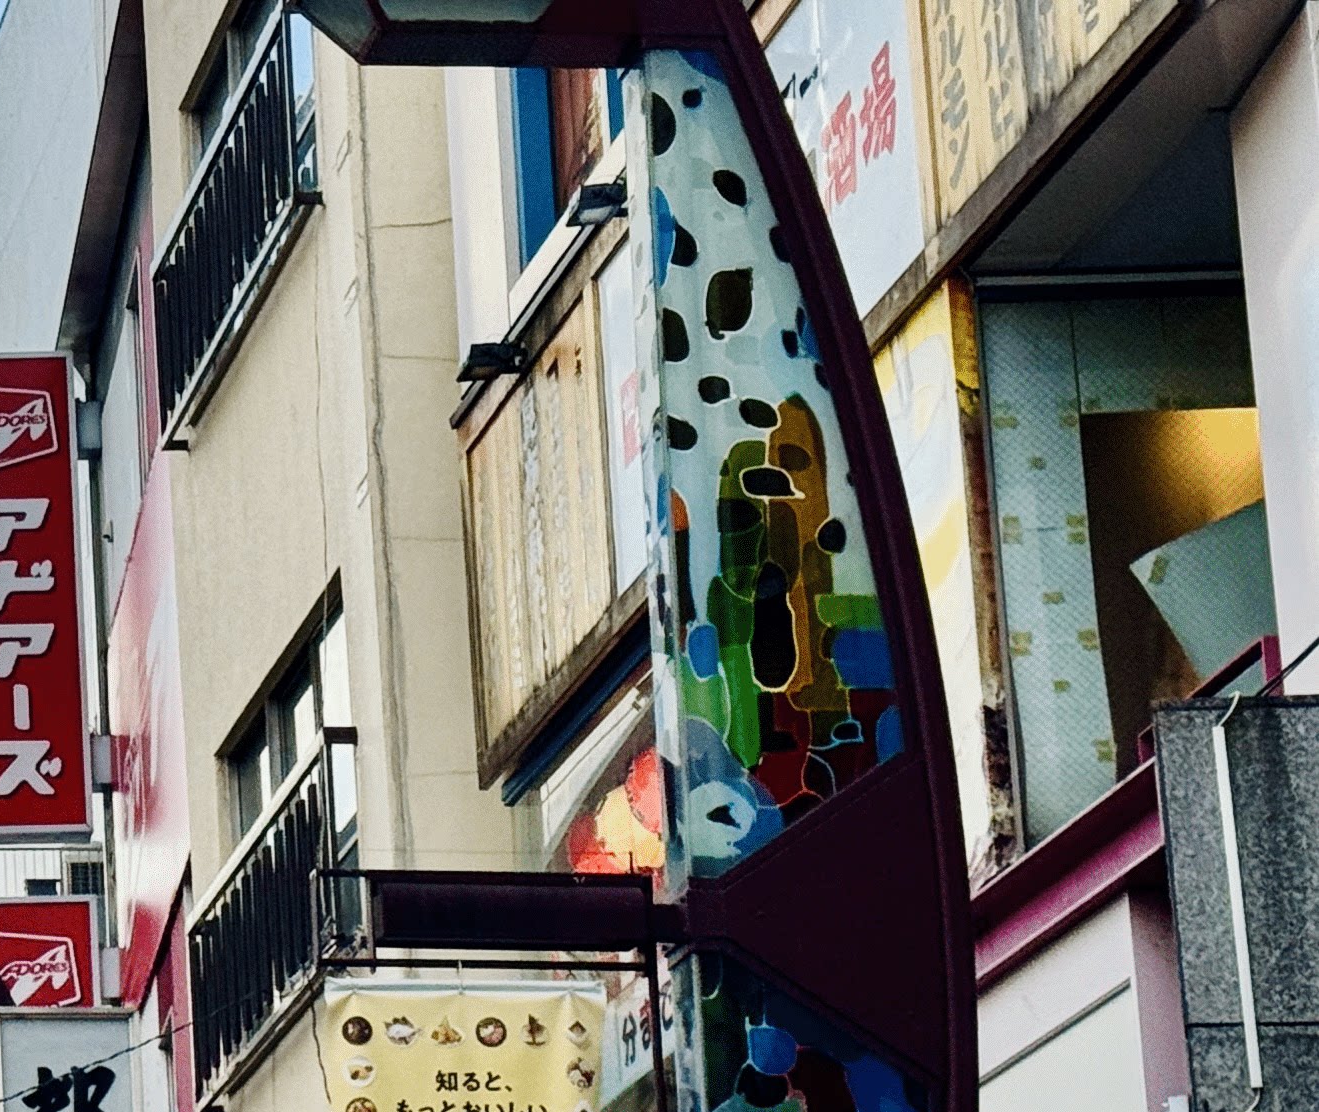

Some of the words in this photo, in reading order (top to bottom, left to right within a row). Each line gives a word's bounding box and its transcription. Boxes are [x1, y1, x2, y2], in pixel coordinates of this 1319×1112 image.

[821, 40, 897, 206] 酒場
[435, 1071, 514, 1093] 知ると、
